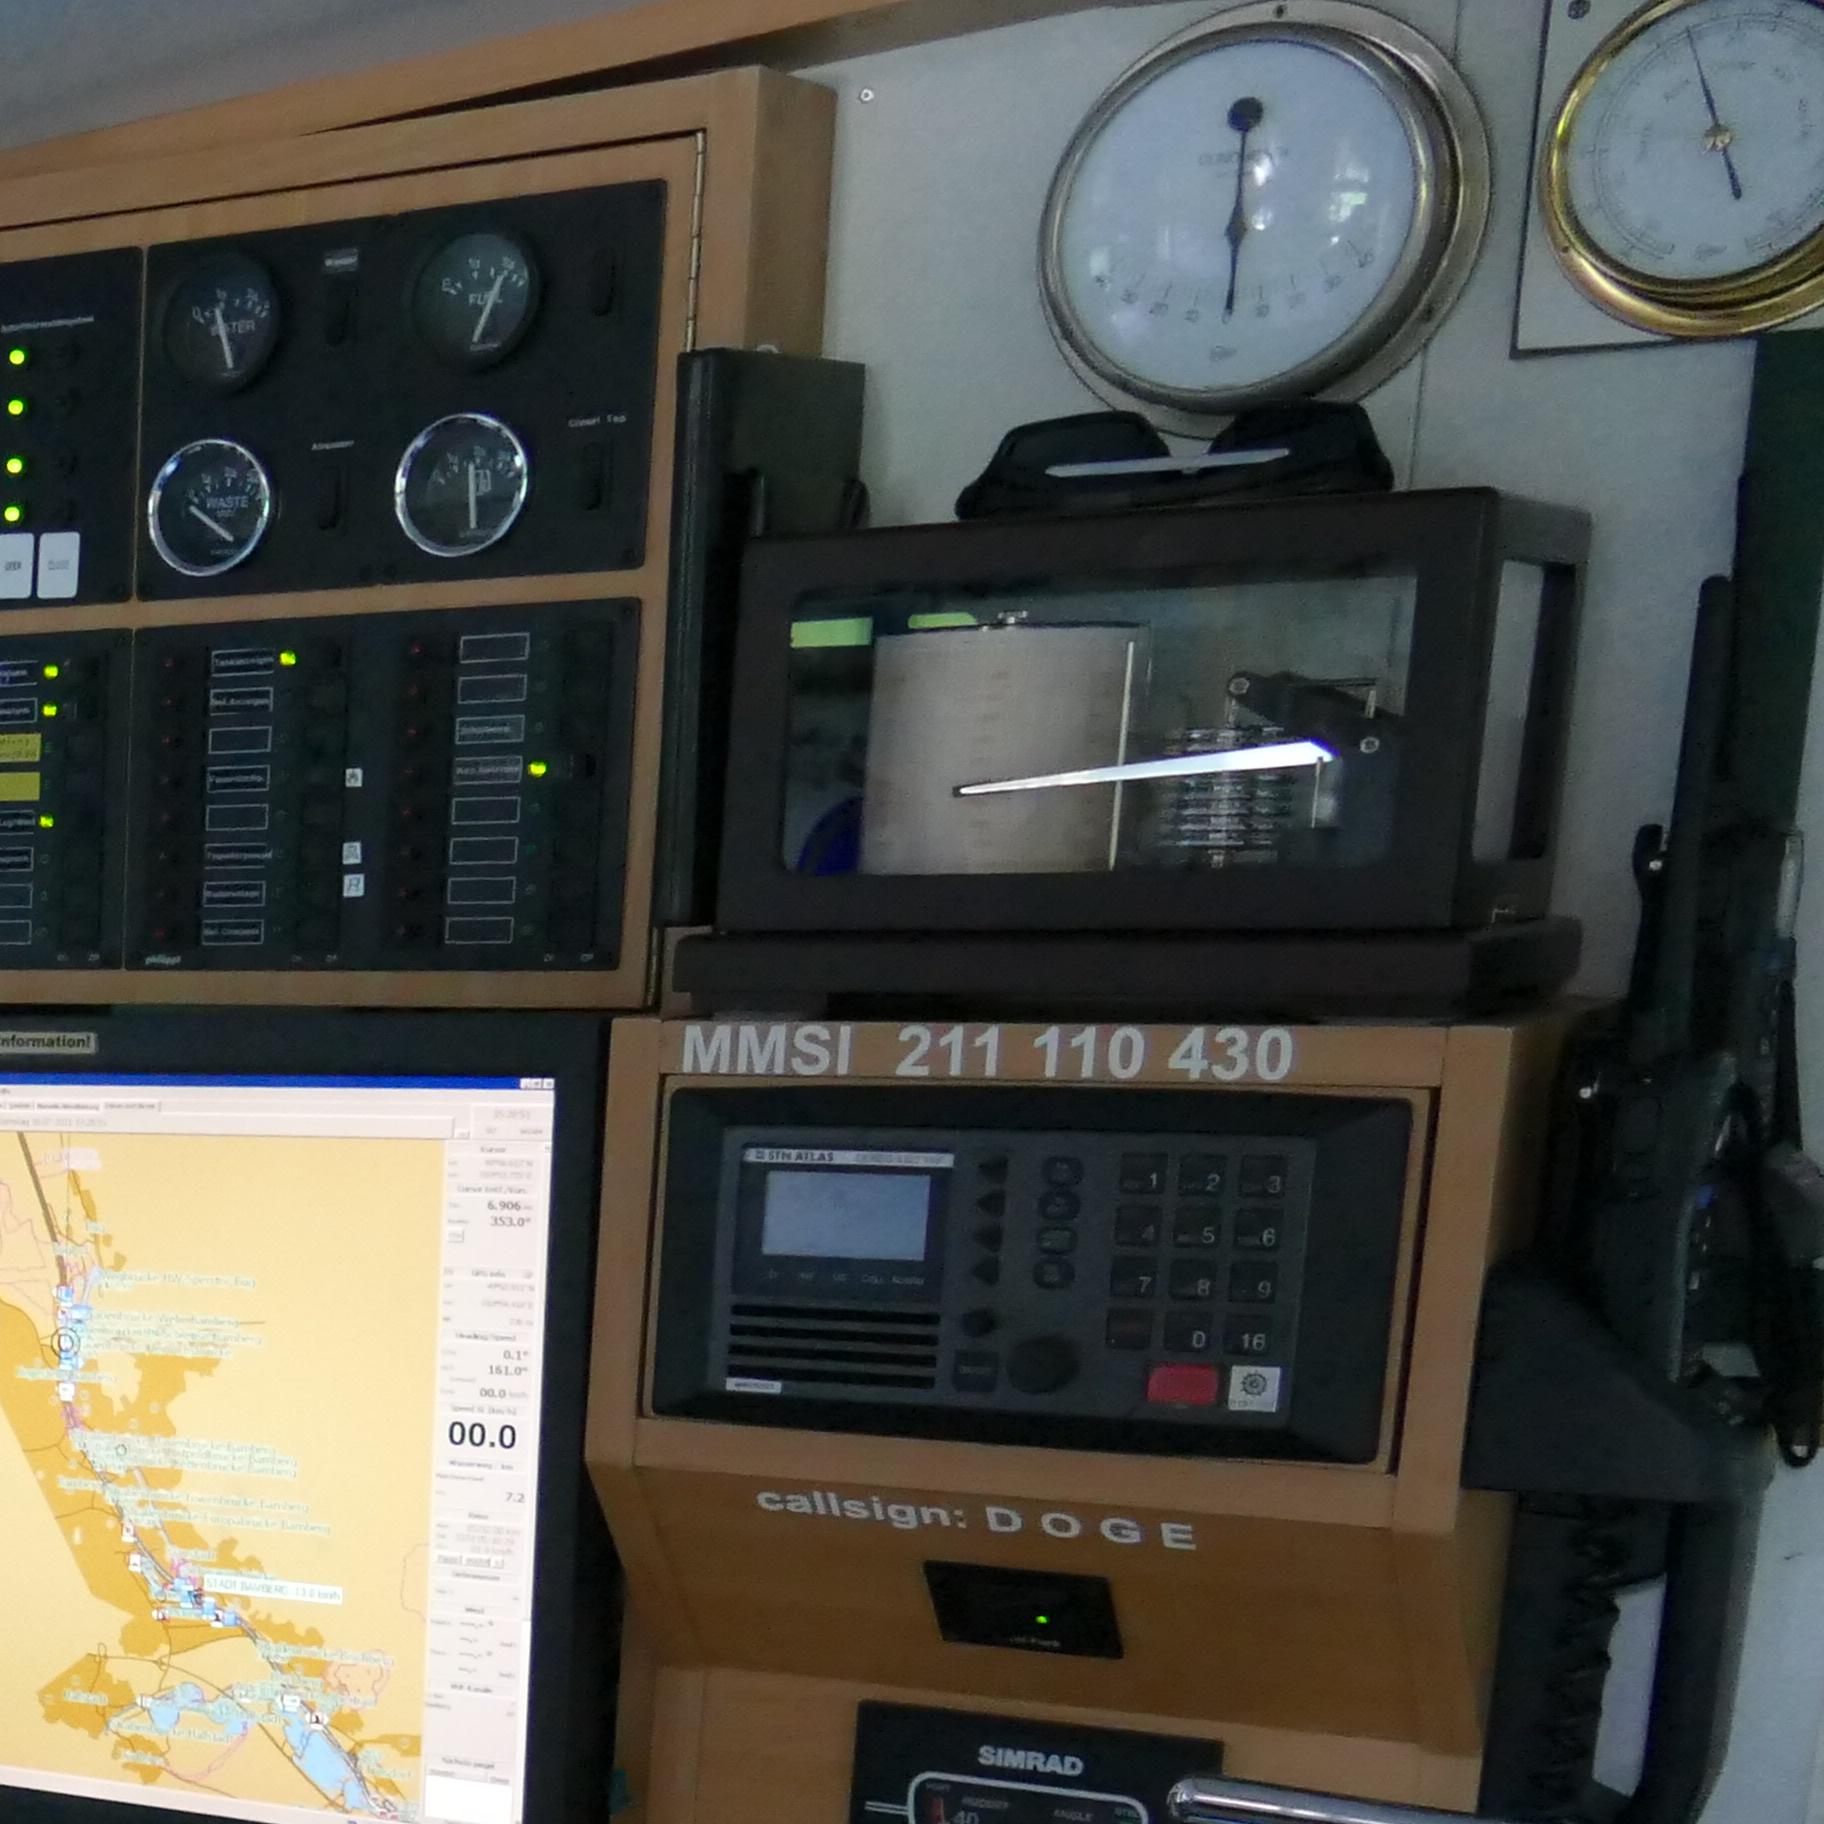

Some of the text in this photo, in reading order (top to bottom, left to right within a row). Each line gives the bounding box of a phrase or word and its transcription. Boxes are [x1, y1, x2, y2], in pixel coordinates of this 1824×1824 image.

[205, 495, 250, 510] WASTE
[682, 1024, 1293, 1081] MMSI 211 110 430
[795, 1151, 834, 1162] ATLAS
[1149, 1172, 1158, 1188] 1
[1206, 1173, 1221, 1192] 2
[1267, 1175, 1281, 1194] 3
[487, 1200, 521, 1212] 6.906
[1202, 1226, 1215, 1244] 5
[1262, 1227, 1276, 1247] 6
[1137, 1276, 1151, 1293] 7
[1197, 1278, 1210, 1297] 8
[1258, 1280, 1272, 1298] 9
[1192, 1330, 1206, 1348] 0
[1241, 1332, 1266, 1351] 16
[503, 1350, 528, 1361] 0.1°
[488, 1365, 528, 1377] 161.0°
[479, 1388, 507, 1399] 00.0
[448, 1421, 517, 1449] 00.0
[505, 1491, 526, 1504] 7.2
[756, 1490, 967, 1530] callsign:
[977, 1745, 1084, 1777] SIMRAD
